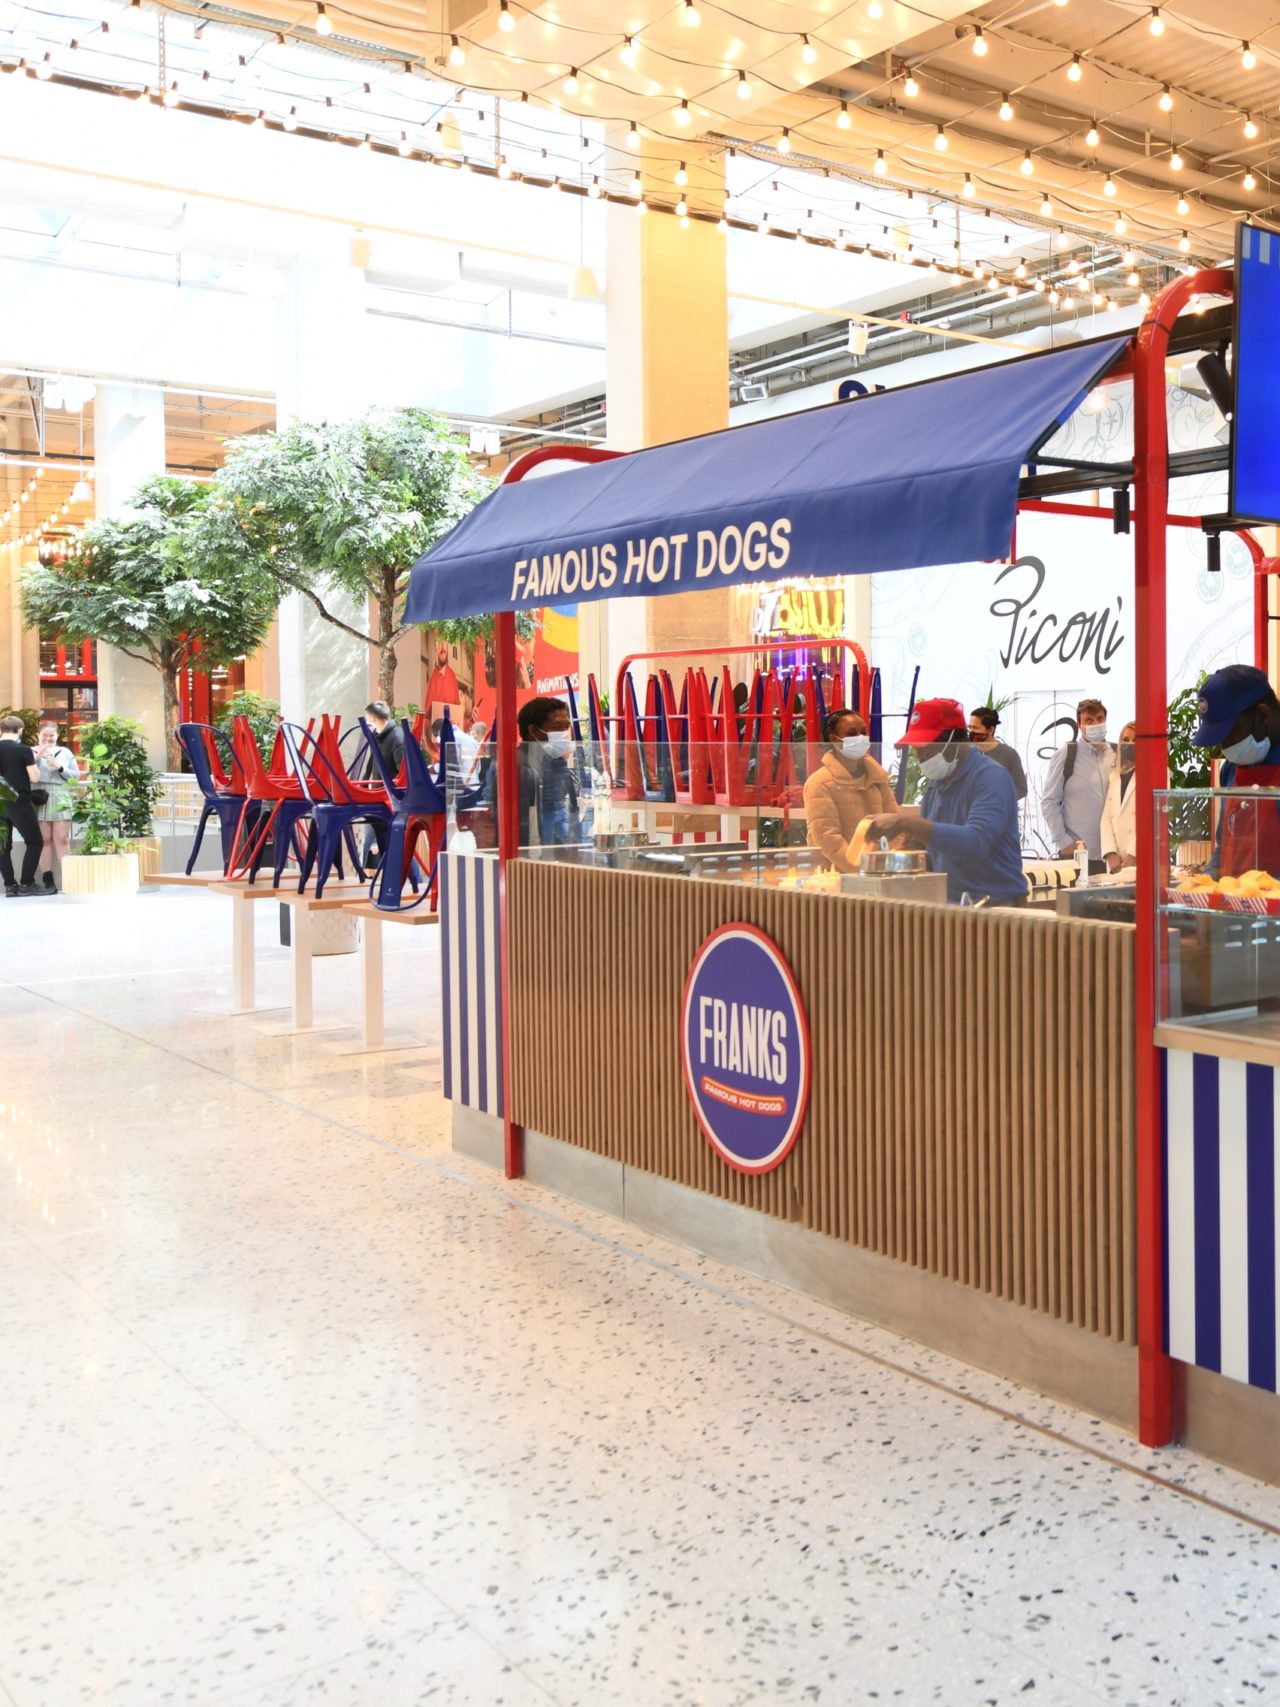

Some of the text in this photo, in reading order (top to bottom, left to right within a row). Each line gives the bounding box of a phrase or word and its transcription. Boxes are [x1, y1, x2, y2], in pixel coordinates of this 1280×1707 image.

[510, 517, 792, 601] FAMOUS HOT DOGS
[989, 555, 1125, 675] Piconi
[700, 995, 787, 1084] FRANKS
[704, 1082, 782, 1112] FAMOUS HOT DOGS
